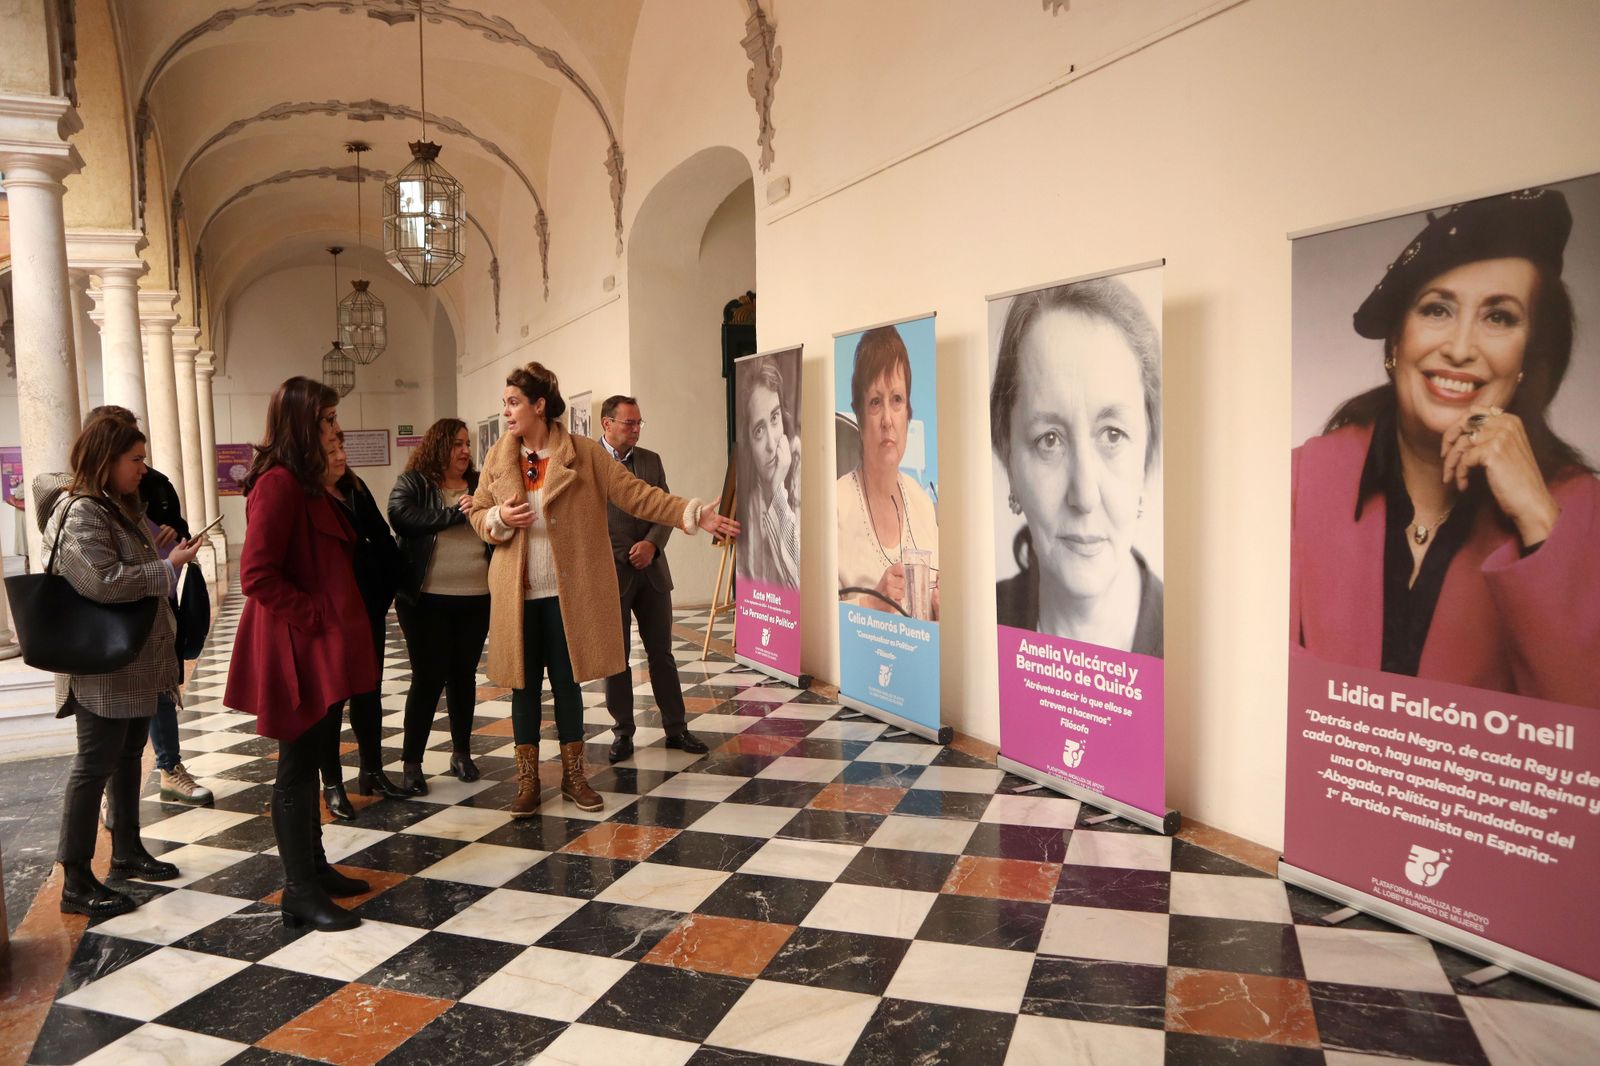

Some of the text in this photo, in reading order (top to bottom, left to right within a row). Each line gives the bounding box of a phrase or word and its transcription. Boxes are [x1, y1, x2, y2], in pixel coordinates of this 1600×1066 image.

[749, 608, 769, 622] Personal
[769, 616, 775, 624] es
[753, 589, 781, 606] Kate Millet
[848, 610, 930, 642] Celia Amorós Puente
[1016, 654, 1143, 701] Bernaldo de Quirós
[1019, 638, 1138, 685] Amelia Valcárcel y
[1039, 698, 1066, 713] atreven
[1066, 707, 1073, 715] a
[1055, 689, 1061, 697] a
[1061, 688, 1079, 702] decir
[1080, 693, 1088, 704] lo
[1088, 698, 1104, 709] que
[1123, 707, 1133, 717] se
[1060, 717, 1089, 735] Filósofa
[1328, 679, 1384, 710] Lidia
[1391, 691, 1477, 729] Falcón
[1302, 729, 1600, 815] cada Obrero, hay una Negra, una Reina y
[1353, 720, 1370, 733] de
[1372, 727, 1405, 742] cada
[1408, 731, 1456, 755] Negro,
[1459, 744, 1479, 759] de
[1481, 751, 1522, 769] cada
[1524, 757, 1558, 781] Rey
[1560, 769, 1573, 785] y
[1576, 770, 1600, 788] de
[1330, 754, 1353, 768] una
[1355, 758, 1404, 781] Obrera
[1406, 773, 1476, 800] apaleada
[1478, 792, 1508, 808] por
[1341, 791, 1391, 815] Partido
[1392, 806, 1462, 838] Feminista
[1464, 829, 1484, 843] en
[1387, 785, 1439, 810] Política
[1440, 803, 1451, 817] y
[1453, 803, 1544, 840] Fundadora
[1546, 831, 1575, 849] del
[1371, 877, 1489, 925] PLATAFORMA ANDALUZA DE APOYO
[1373, 886, 1485, 932] AL LOBBY EUROPEO DE MUJERES
